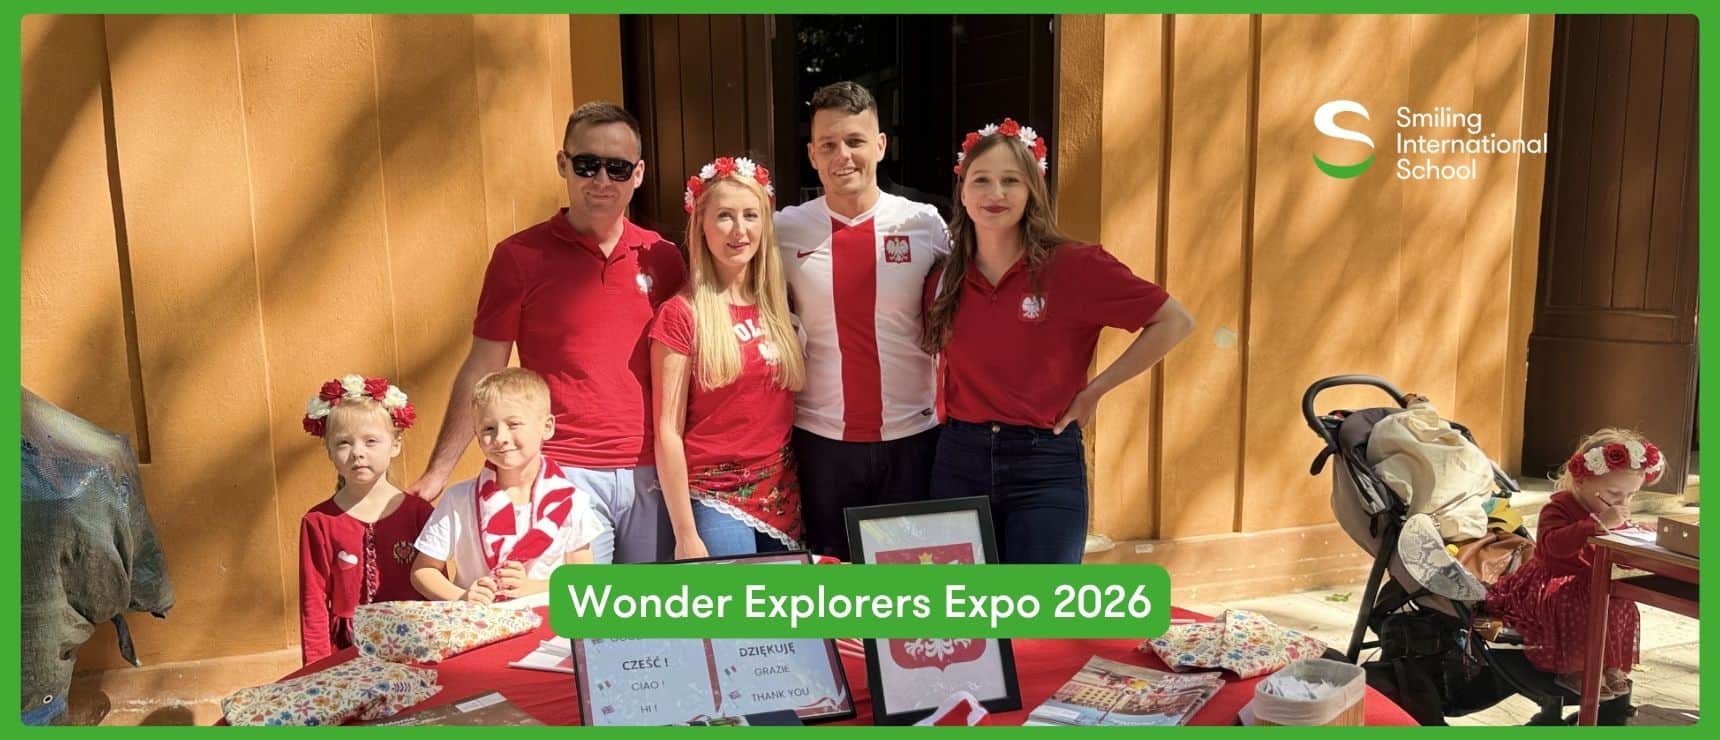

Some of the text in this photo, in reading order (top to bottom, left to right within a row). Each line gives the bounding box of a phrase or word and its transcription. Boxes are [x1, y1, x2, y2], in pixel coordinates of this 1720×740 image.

[739, 641, 797, 657] DZIĘKUJĘ
[622, 656, 661, 671] CZEŚĆ
[753, 664, 790, 677] GRAZIE
[631, 680, 659, 692] CIAO
[751, 686, 810, 703] THANK YOU
[640, 704, 651, 714] HI
